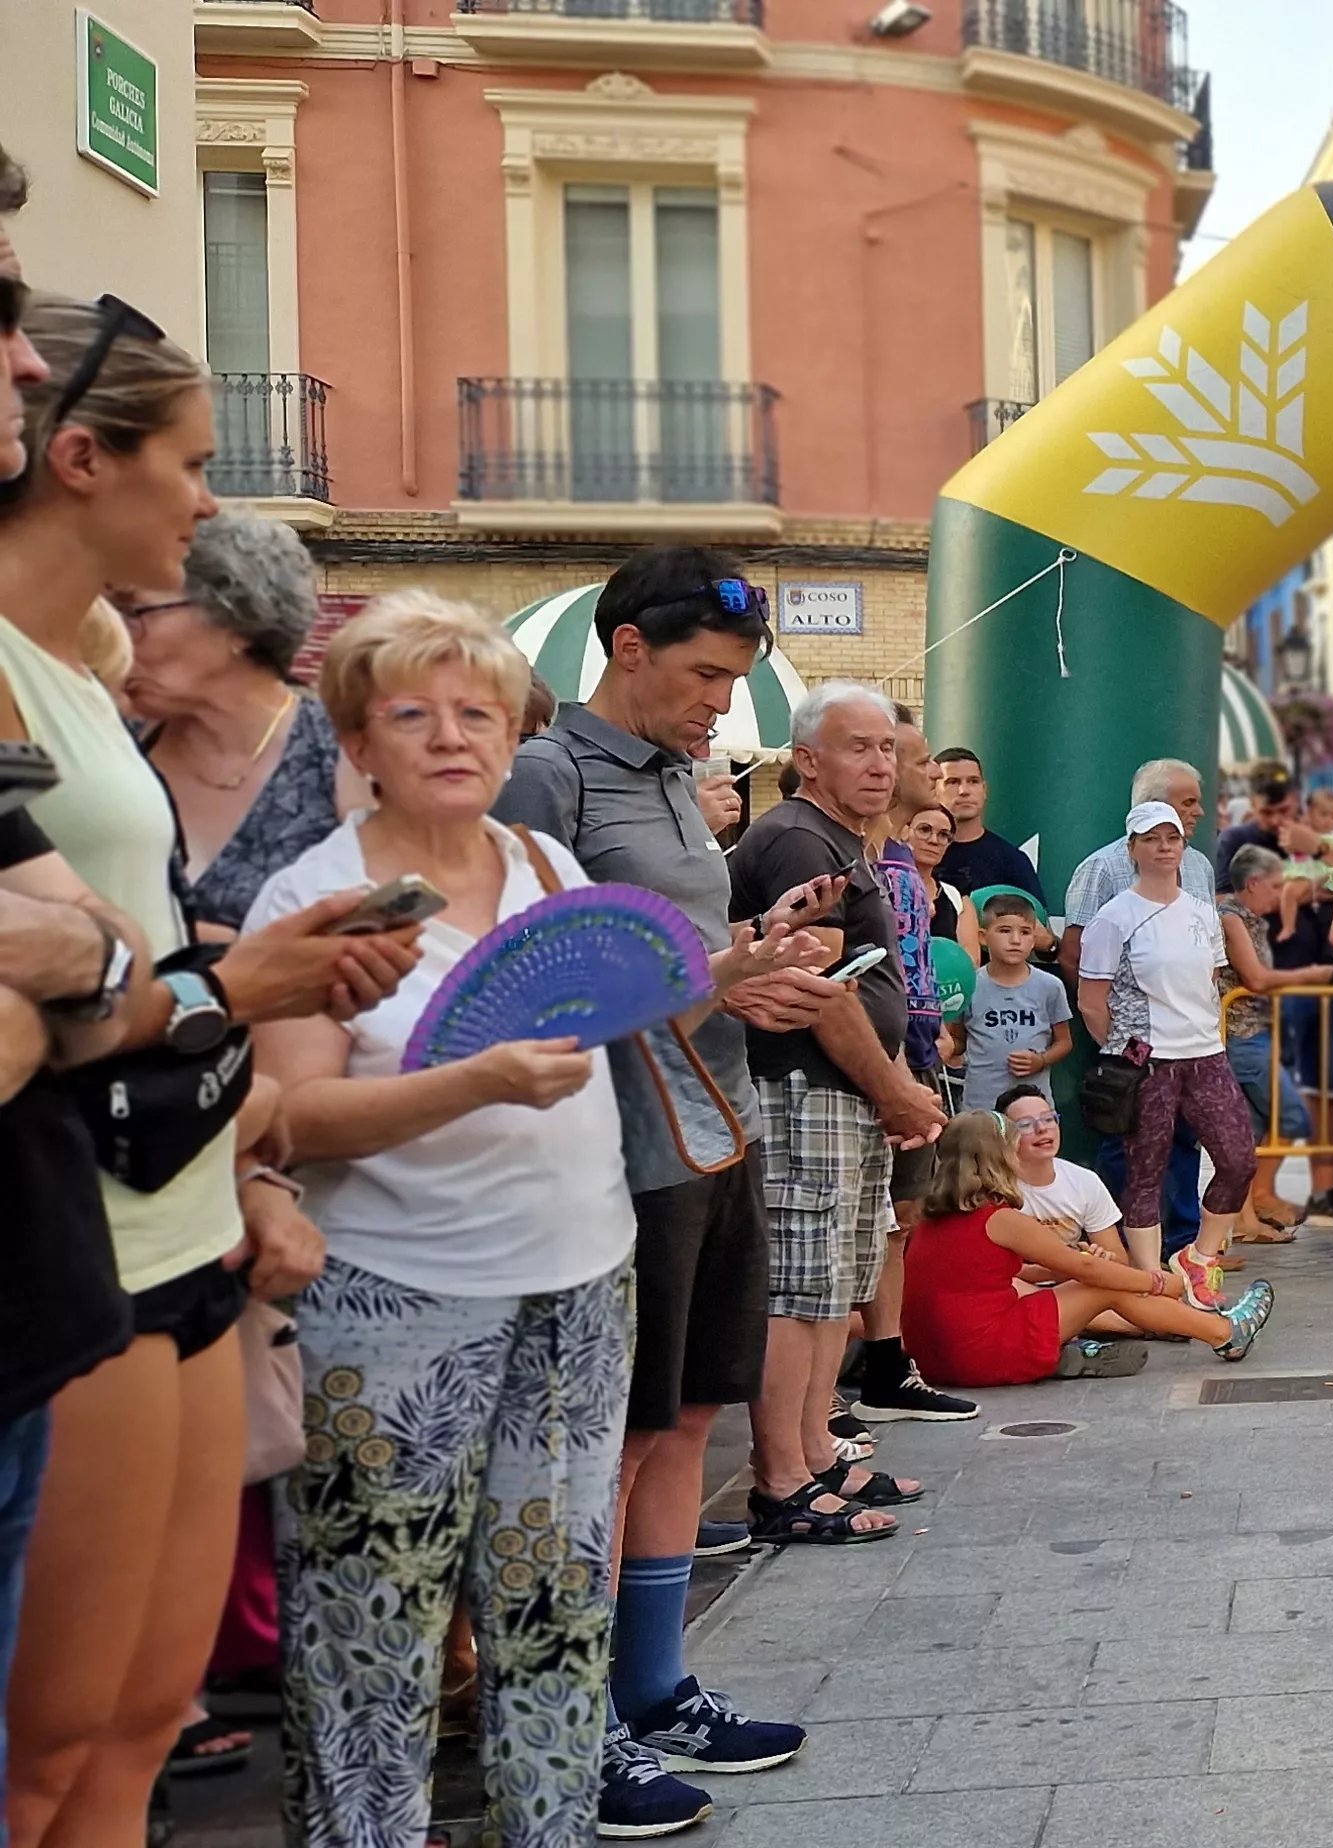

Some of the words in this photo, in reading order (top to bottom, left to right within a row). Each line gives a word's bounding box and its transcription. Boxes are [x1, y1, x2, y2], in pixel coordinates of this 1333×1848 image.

[106, 67, 146, 110] PORCHES
[92, 110, 126, 147] Comunidad
[109, 95, 145, 135] GALICIA
[808, 592, 848, 602] COSO
[791, 614, 852, 626] ALTO
